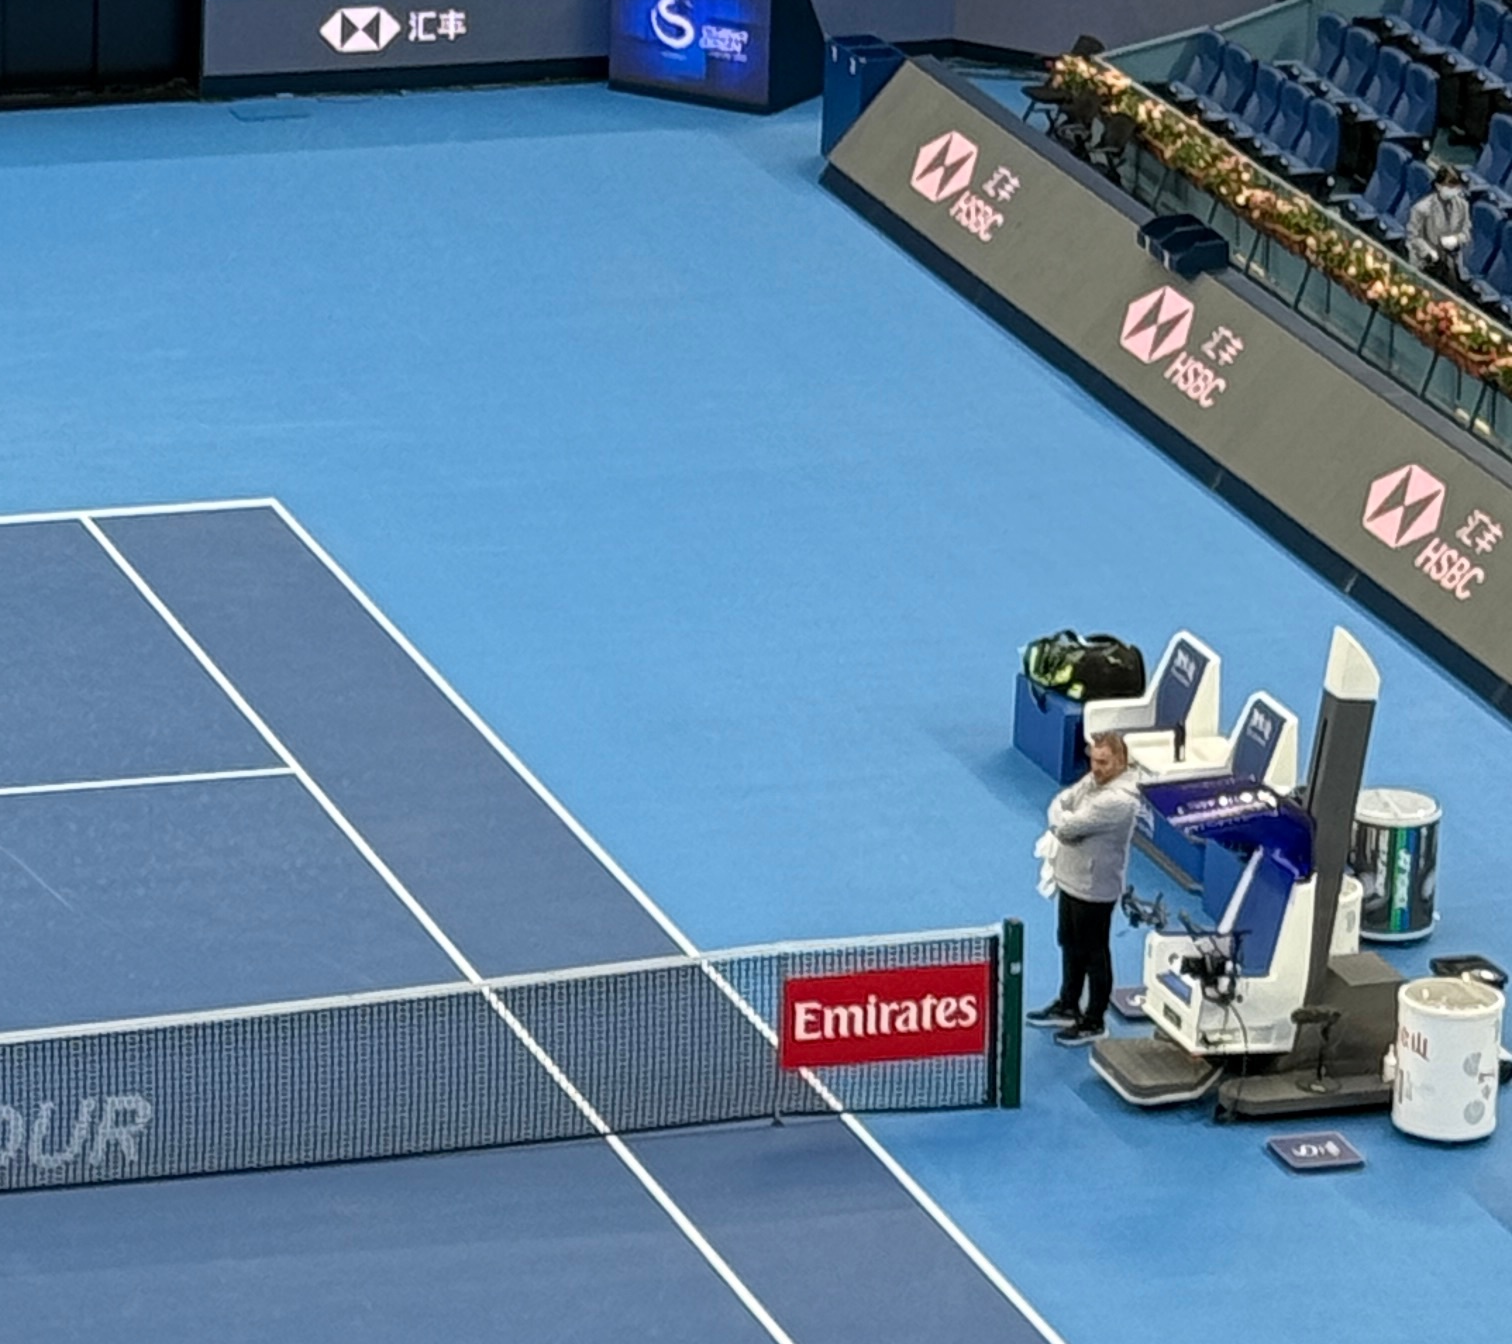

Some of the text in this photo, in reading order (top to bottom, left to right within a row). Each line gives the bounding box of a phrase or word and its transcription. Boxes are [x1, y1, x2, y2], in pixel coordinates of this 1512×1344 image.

[949, 189, 1004, 242] HSBC
[1163, 350, 1227, 409] HSBC
[1414, 537, 1486, 601] HSBC
[793, 992, 979, 1042] Emirates
